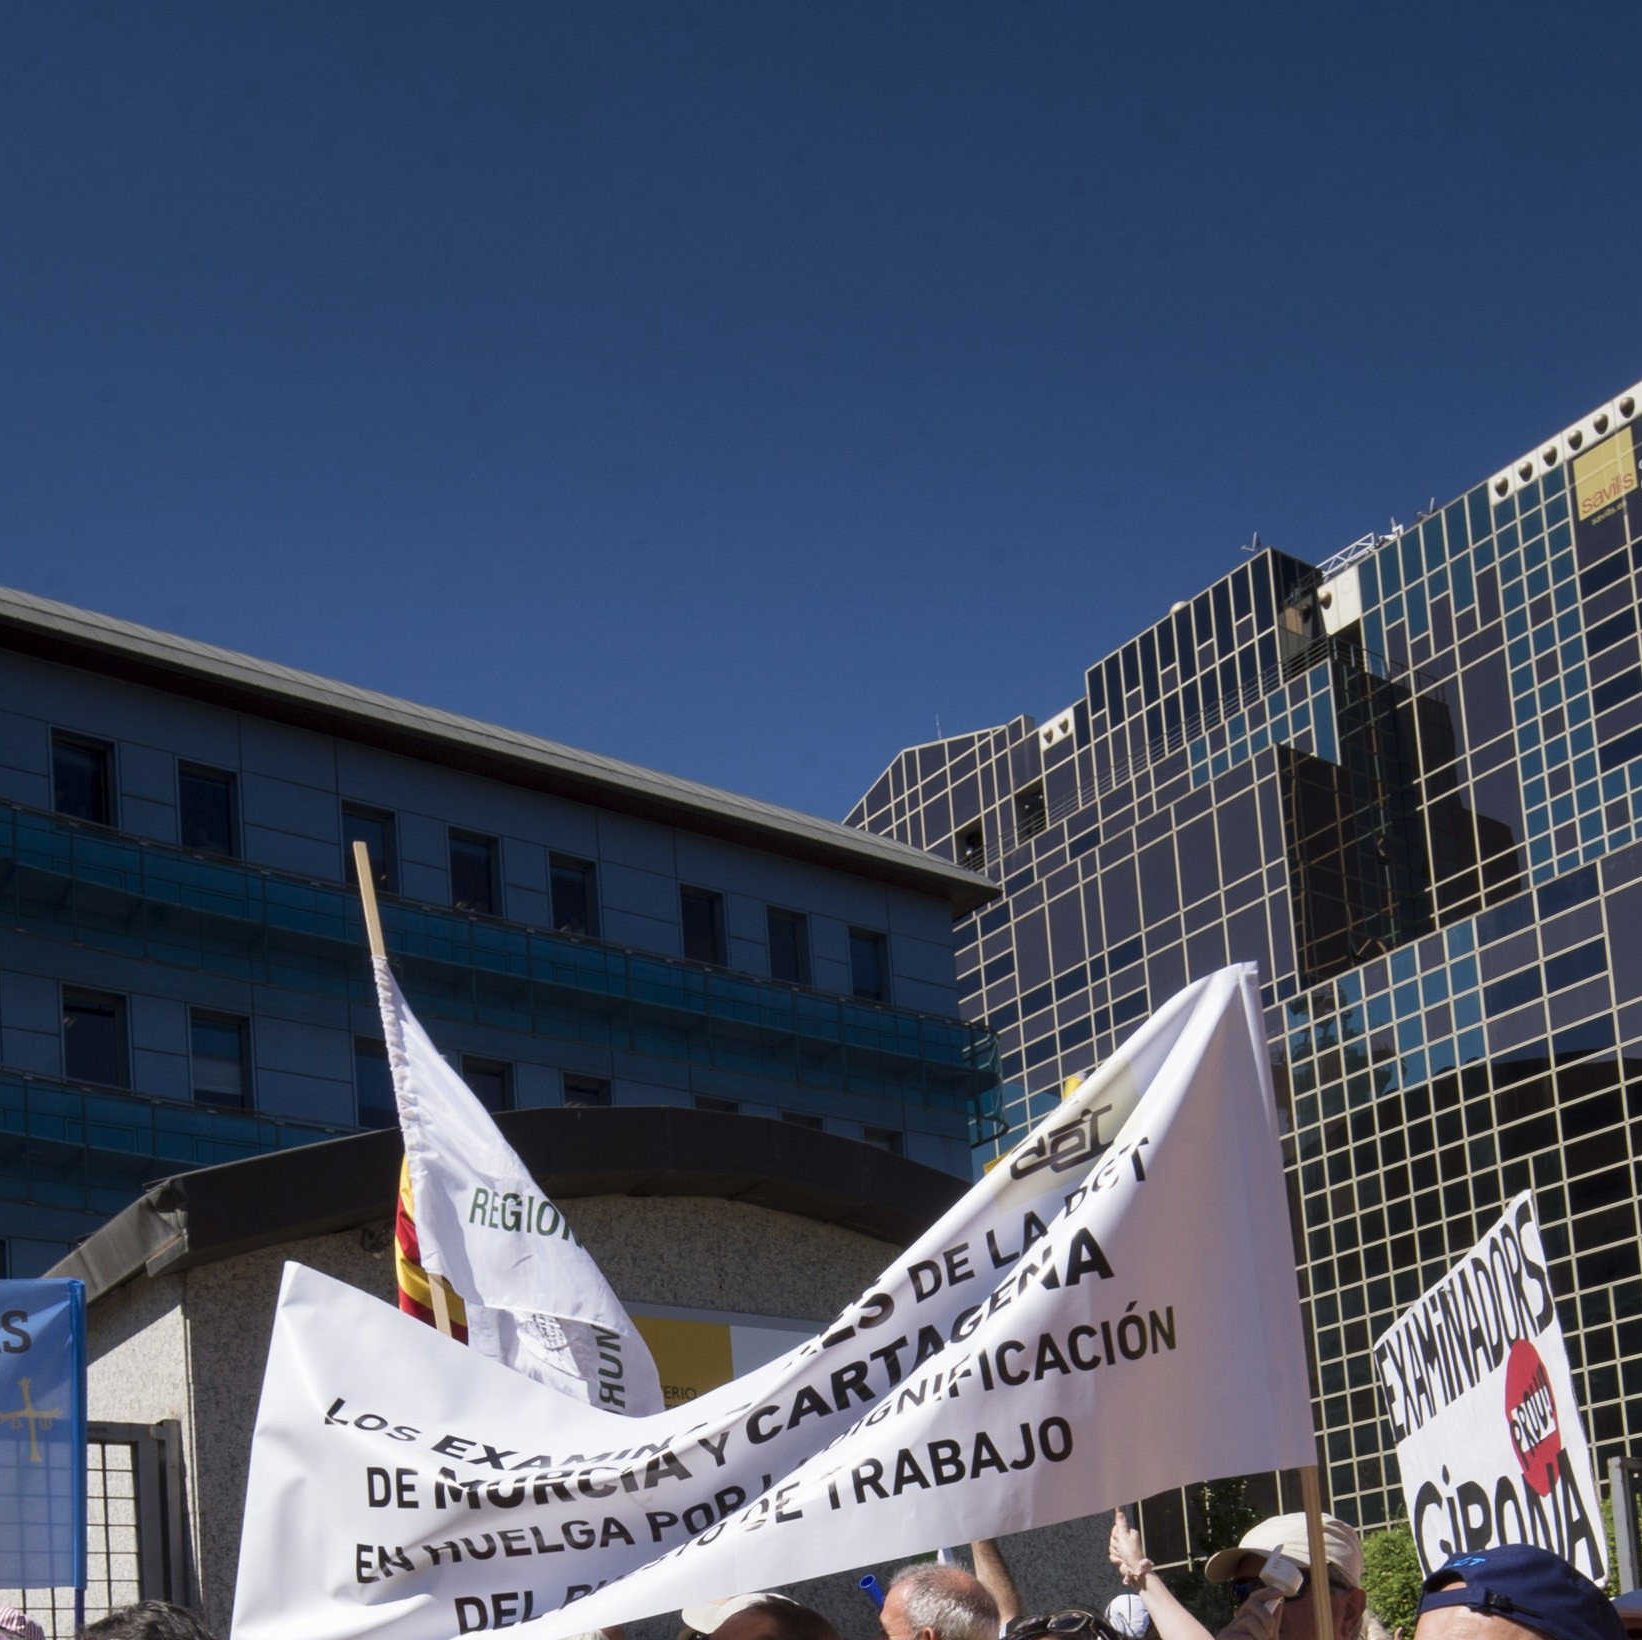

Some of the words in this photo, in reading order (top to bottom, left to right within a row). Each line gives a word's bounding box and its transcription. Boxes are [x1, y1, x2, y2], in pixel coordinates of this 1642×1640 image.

[324, 1397, 422, 1442] LOS
[908, 1234, 976, 1305] DE
[988, 1209, 1049, 1266] LA
[366, 1465, 420, 1510] DE
[433, 1450, 694, 1510] MURCIA
[697, 1430, 731, 1468] Y
[745, 1226, 1115, 1446] CARTAGENA
[819, 1415, 1074, 1512] TRABAJO
[356, 1542, 415, 1585] EN
[423, 1515, 635, 1567] HUELGA
[645, 1484, 747, 1543] POR
[454, 1589, 544, 1636] DEL
